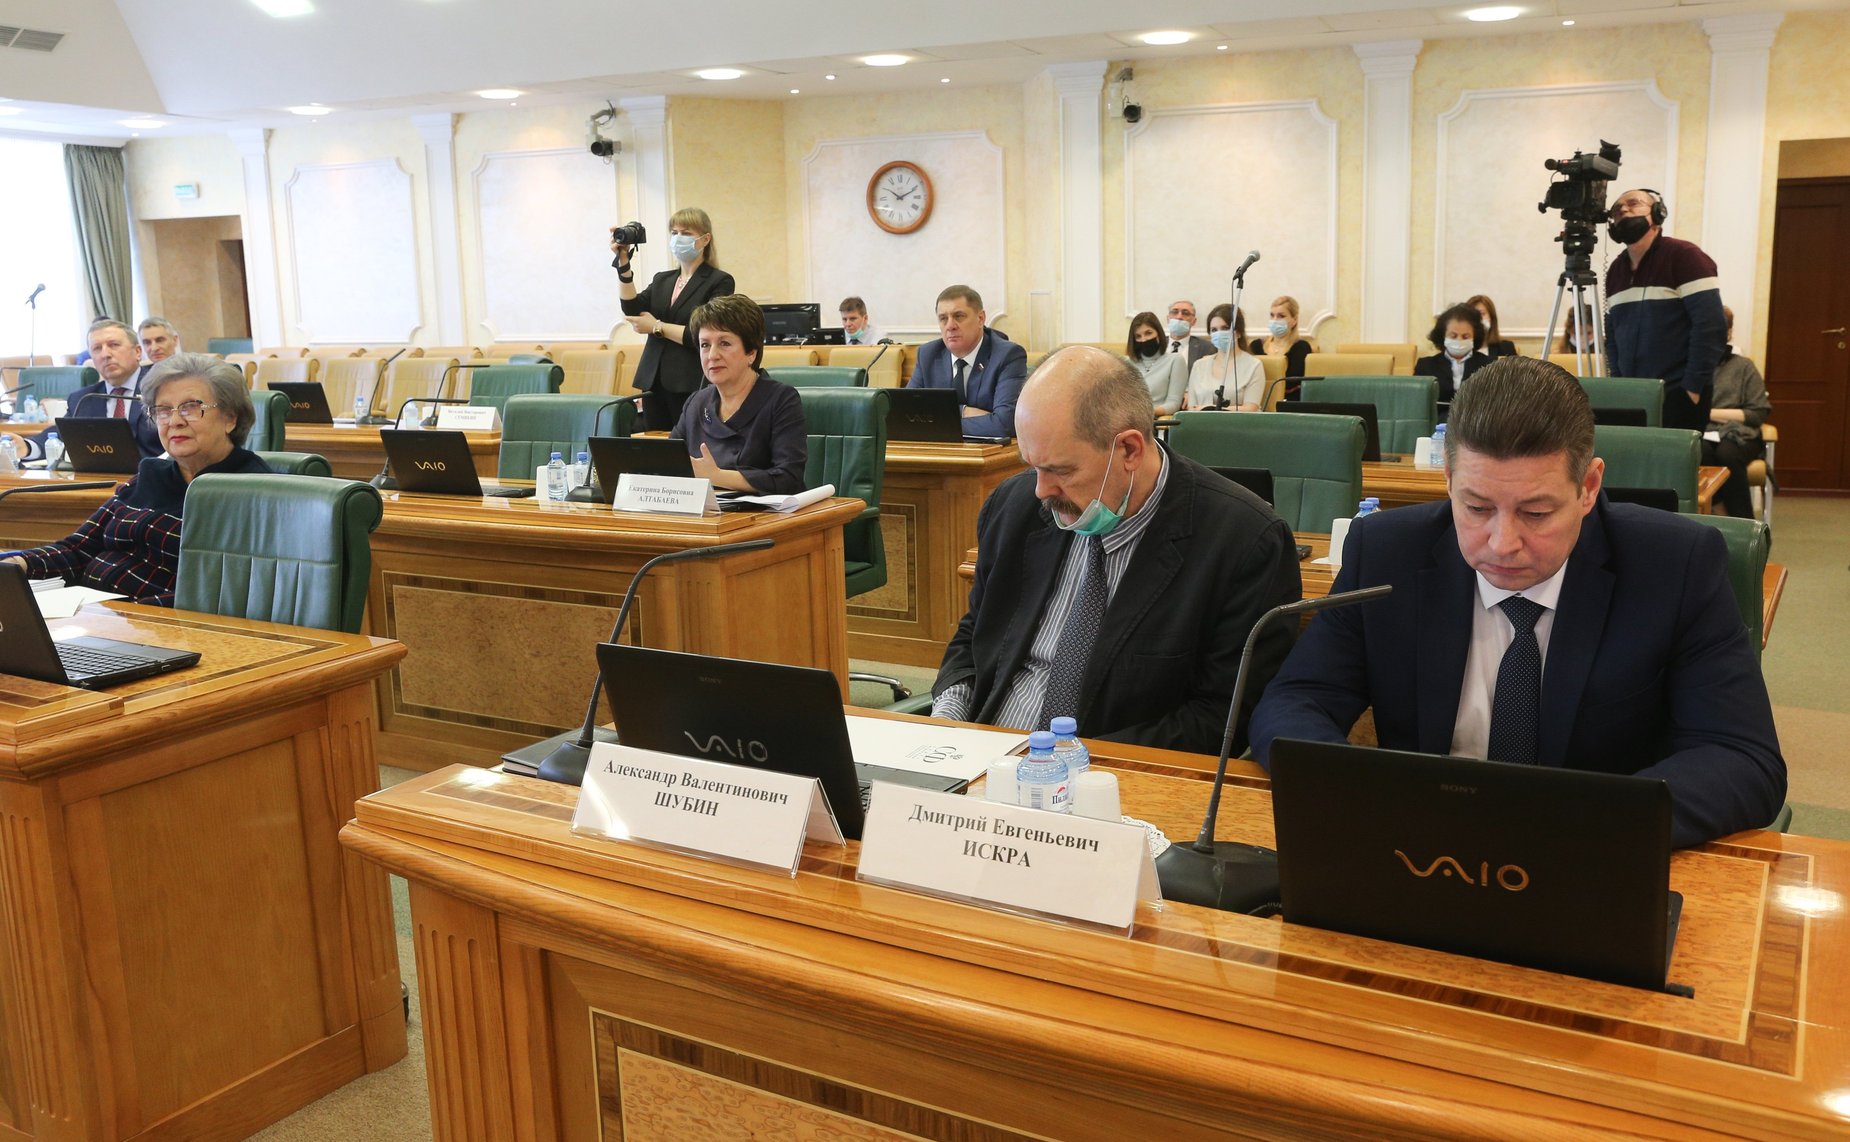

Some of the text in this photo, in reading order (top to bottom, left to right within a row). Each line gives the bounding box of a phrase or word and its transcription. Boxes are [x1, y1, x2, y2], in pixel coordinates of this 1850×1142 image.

[86, 445, 114, 454] VAIO
[414, 461, 446, 471] VAIO
[629, 484, 694, 497] Екатерина Борисовна
[638, 495, 680, 505] АЛТАБАЕВА
[684, 730, 768, 762] VAIO
[603, 760, 789, 805] Александр Валентинович
[654, 791, 720, 817] ШУБИН
[908, 803, 1100, 852] Дмитрий Евгеньевич
[962, 839, 1031, 867] ИСКРА
[1394, 849, 1530, 892] VAIO
